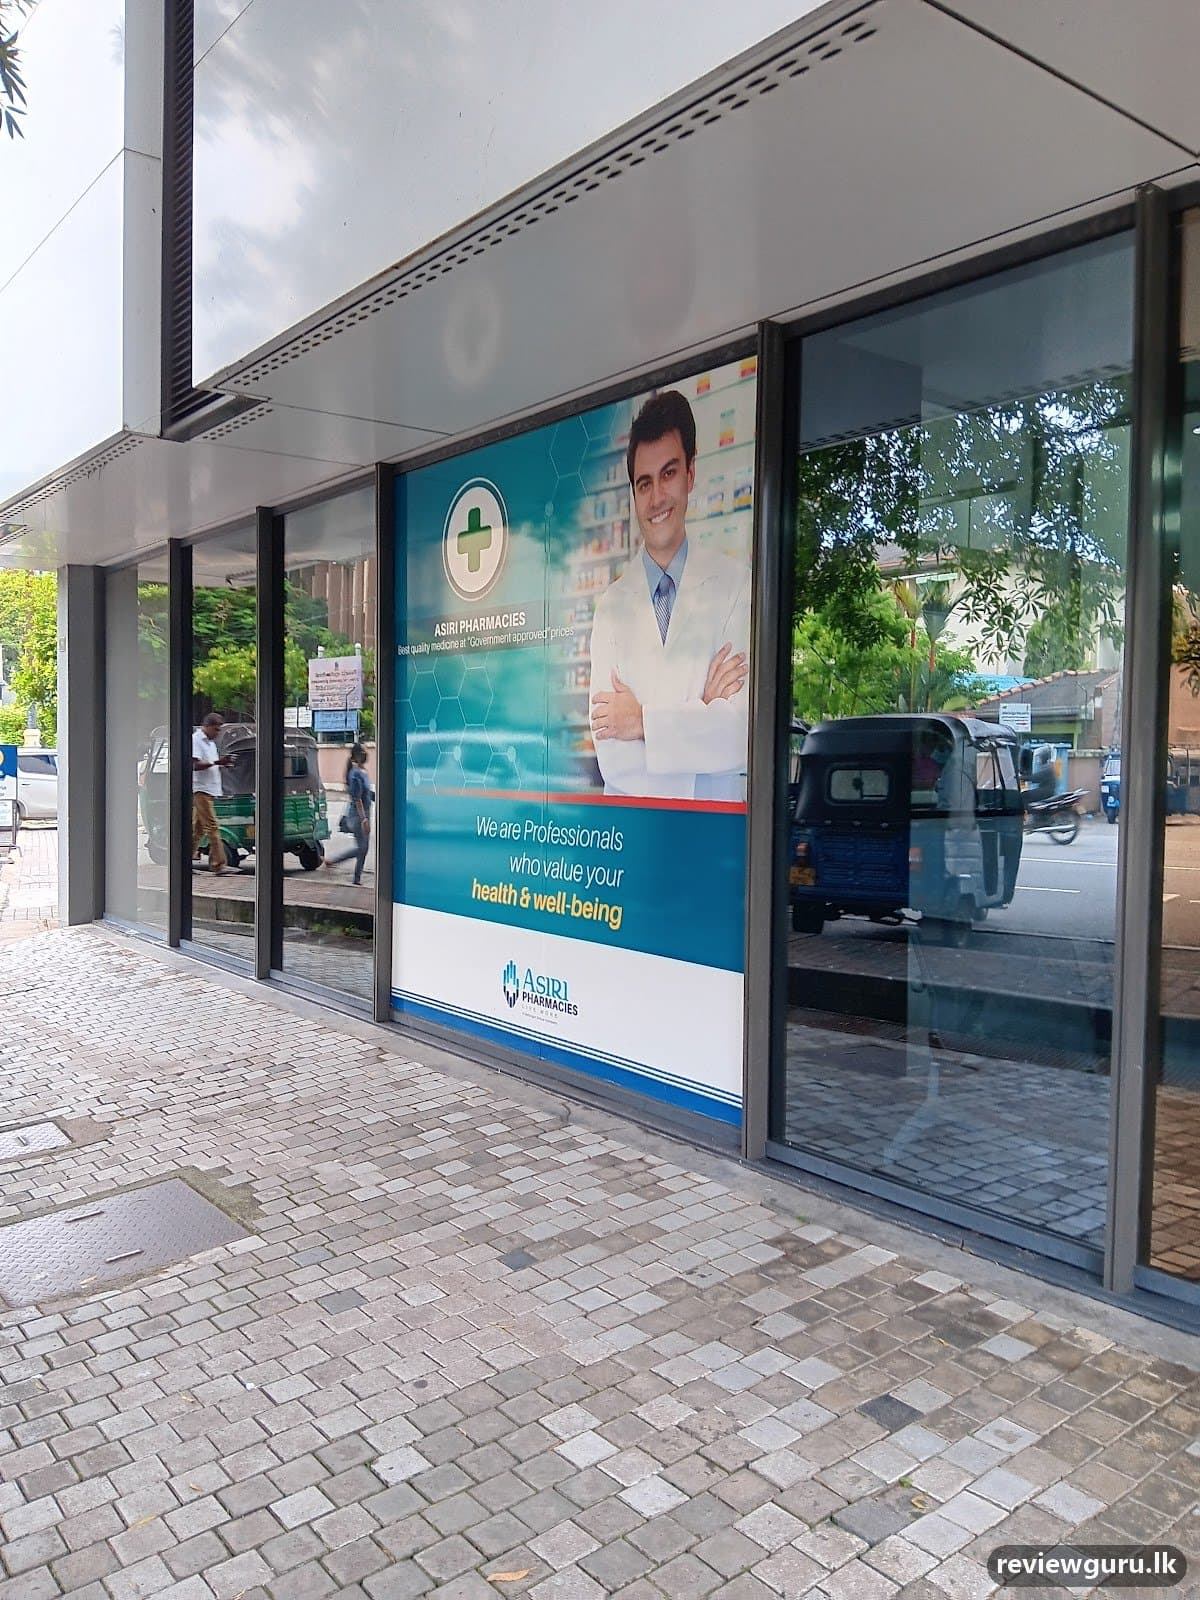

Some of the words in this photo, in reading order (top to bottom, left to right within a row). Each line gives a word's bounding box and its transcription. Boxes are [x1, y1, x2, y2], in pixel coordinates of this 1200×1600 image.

[410, 641, 431, 657] quality
[431, 639, 459, 652] medicine
[459, 637, 466, 648] at
[550, 625, 574, 641] prices
[434, 621, 458, 638] ASIRI
[459, 611, 526, 634] PHARMACIES
[476, 815, 497, 838] We
[499, 822, 521, 841] are
[524, 819, 624, 852] Professionals
[509, 852, 541, 876] who
[543, 856, 584, 882] value
[585, 865, 625, 889] your
[471, 877, 518, 906] health
[519, 886, 531, 908] &
[533, 890, 623, 931] well-being
[522, 991, 578, 1016] PHARMACIES
